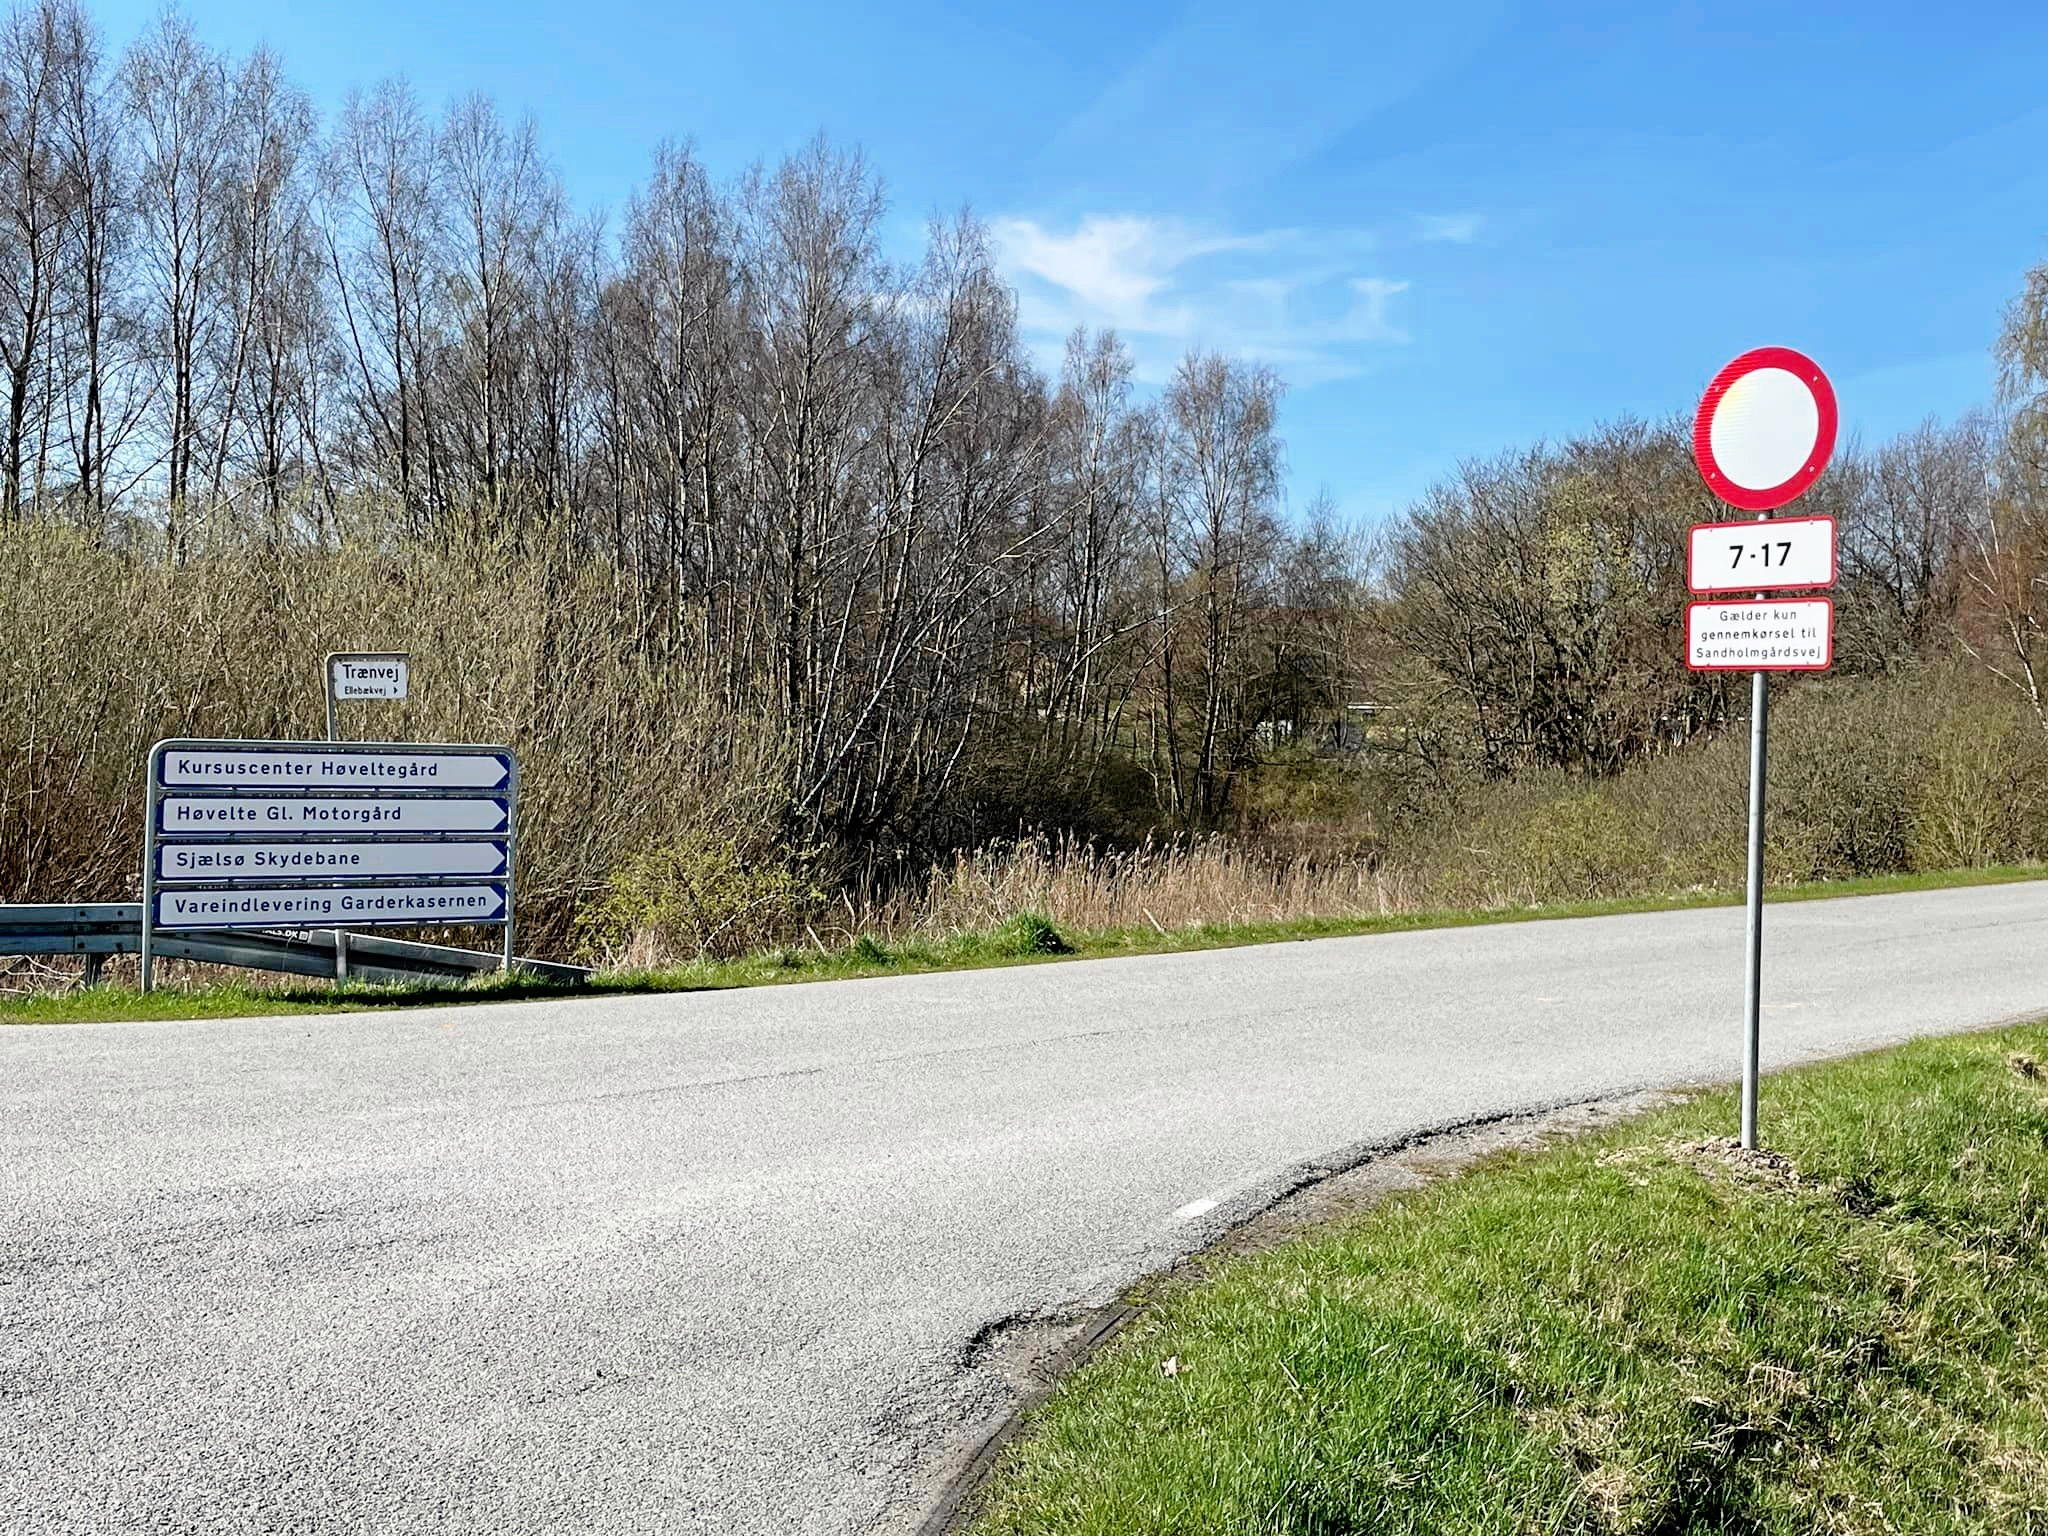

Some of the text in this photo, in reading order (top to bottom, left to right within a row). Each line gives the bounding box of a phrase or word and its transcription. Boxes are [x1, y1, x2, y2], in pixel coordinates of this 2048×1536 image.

[1729, 541, 1792, 569] 7-17
[1719, 609, 1797, 622] Gælder kun
[1701, 627, 1817, 642] gennemkørsel til
[1696, 645, 1821, 660] Sandholmgårdsvej
[342, 664, 399, 682] Trænvej
[344, 686, 386, 696] Ellebækvej
[178, 759, 438, 778] Kursuscenter Høveltegård
[177, 806, 402, 823] Høvelte Gl. Motorgård
[176, 850, 360, 868] Sjælsø Skydebane
[175, 894, 487, 914] Vareindlevering Garderkasernen
